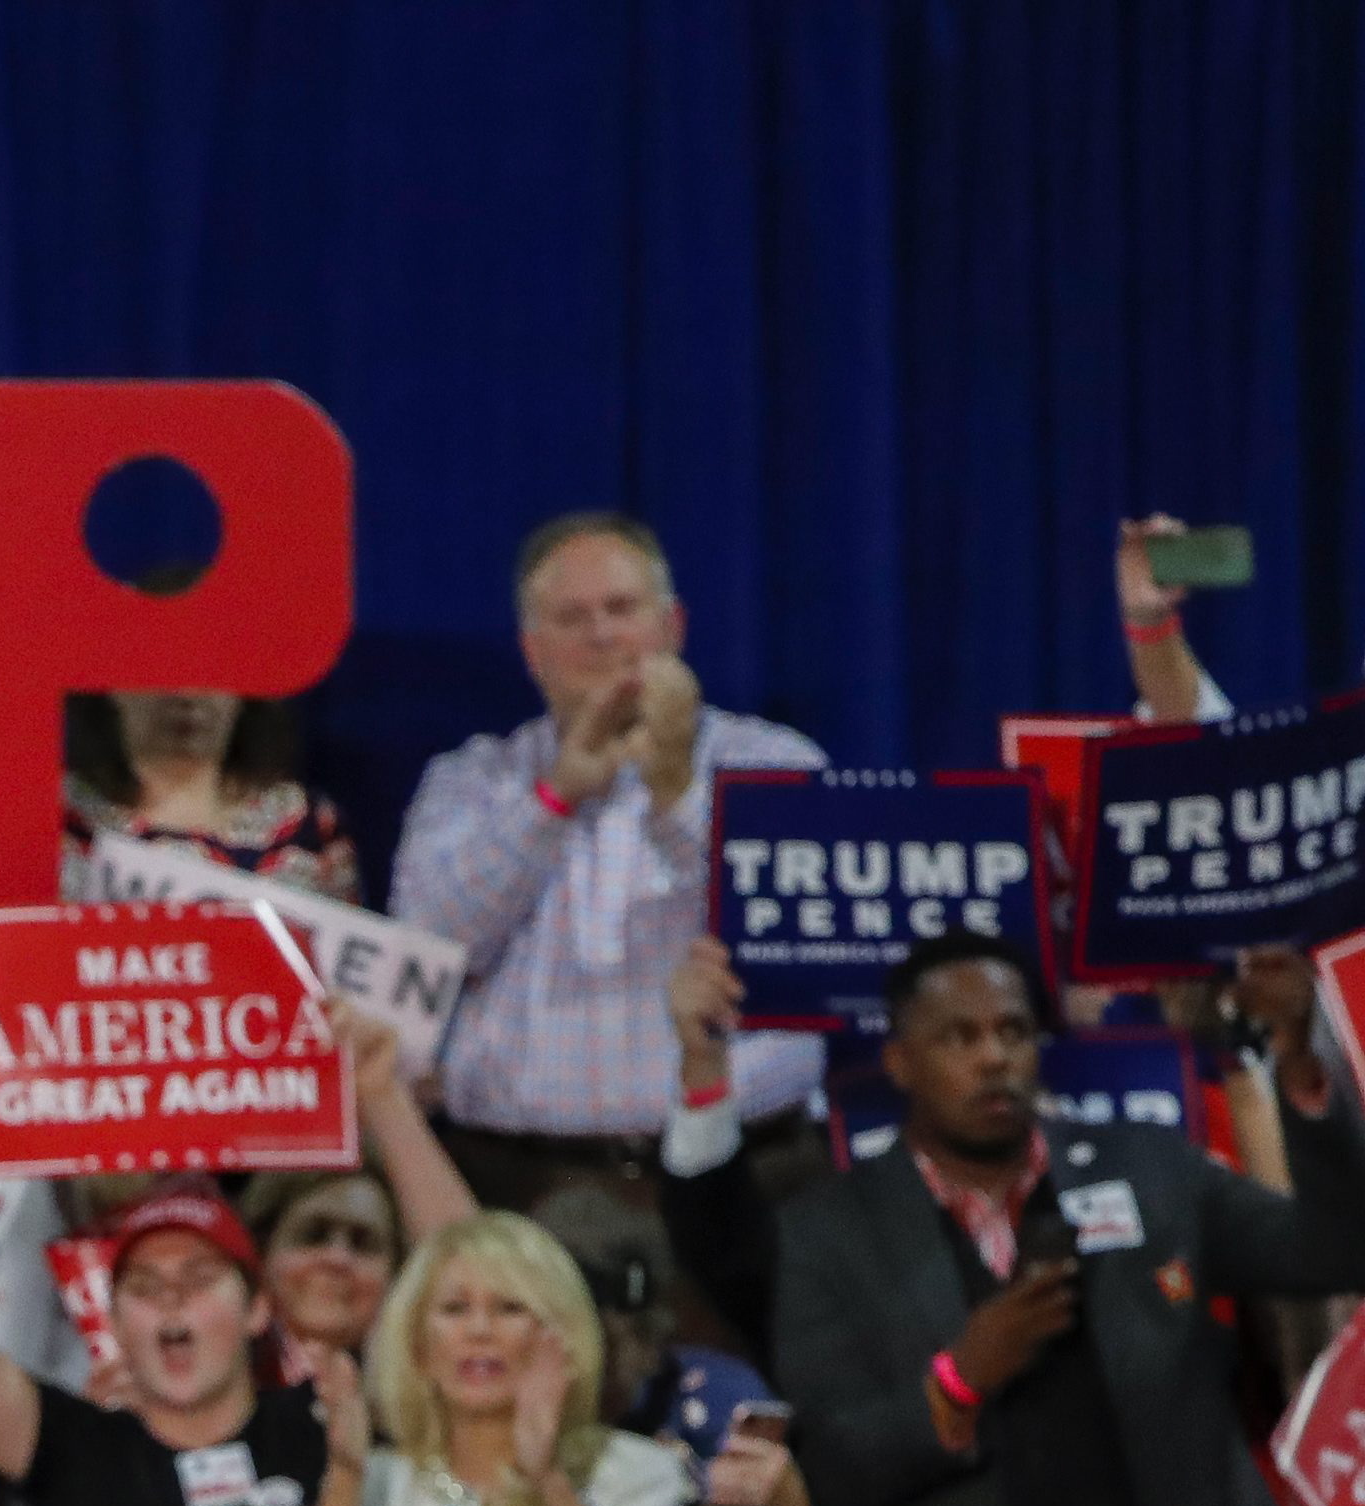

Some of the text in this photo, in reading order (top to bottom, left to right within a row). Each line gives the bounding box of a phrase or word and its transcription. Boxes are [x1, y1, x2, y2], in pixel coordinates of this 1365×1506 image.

[722, 839, 1029, 898] TRUMP
[1130, 817, 1358, 892] PENCE
[743, 897, 1003, 939] PENCE
[76, 942, 213, 987] MAKE
[168, 1066, 320, 1119] AGAIN
